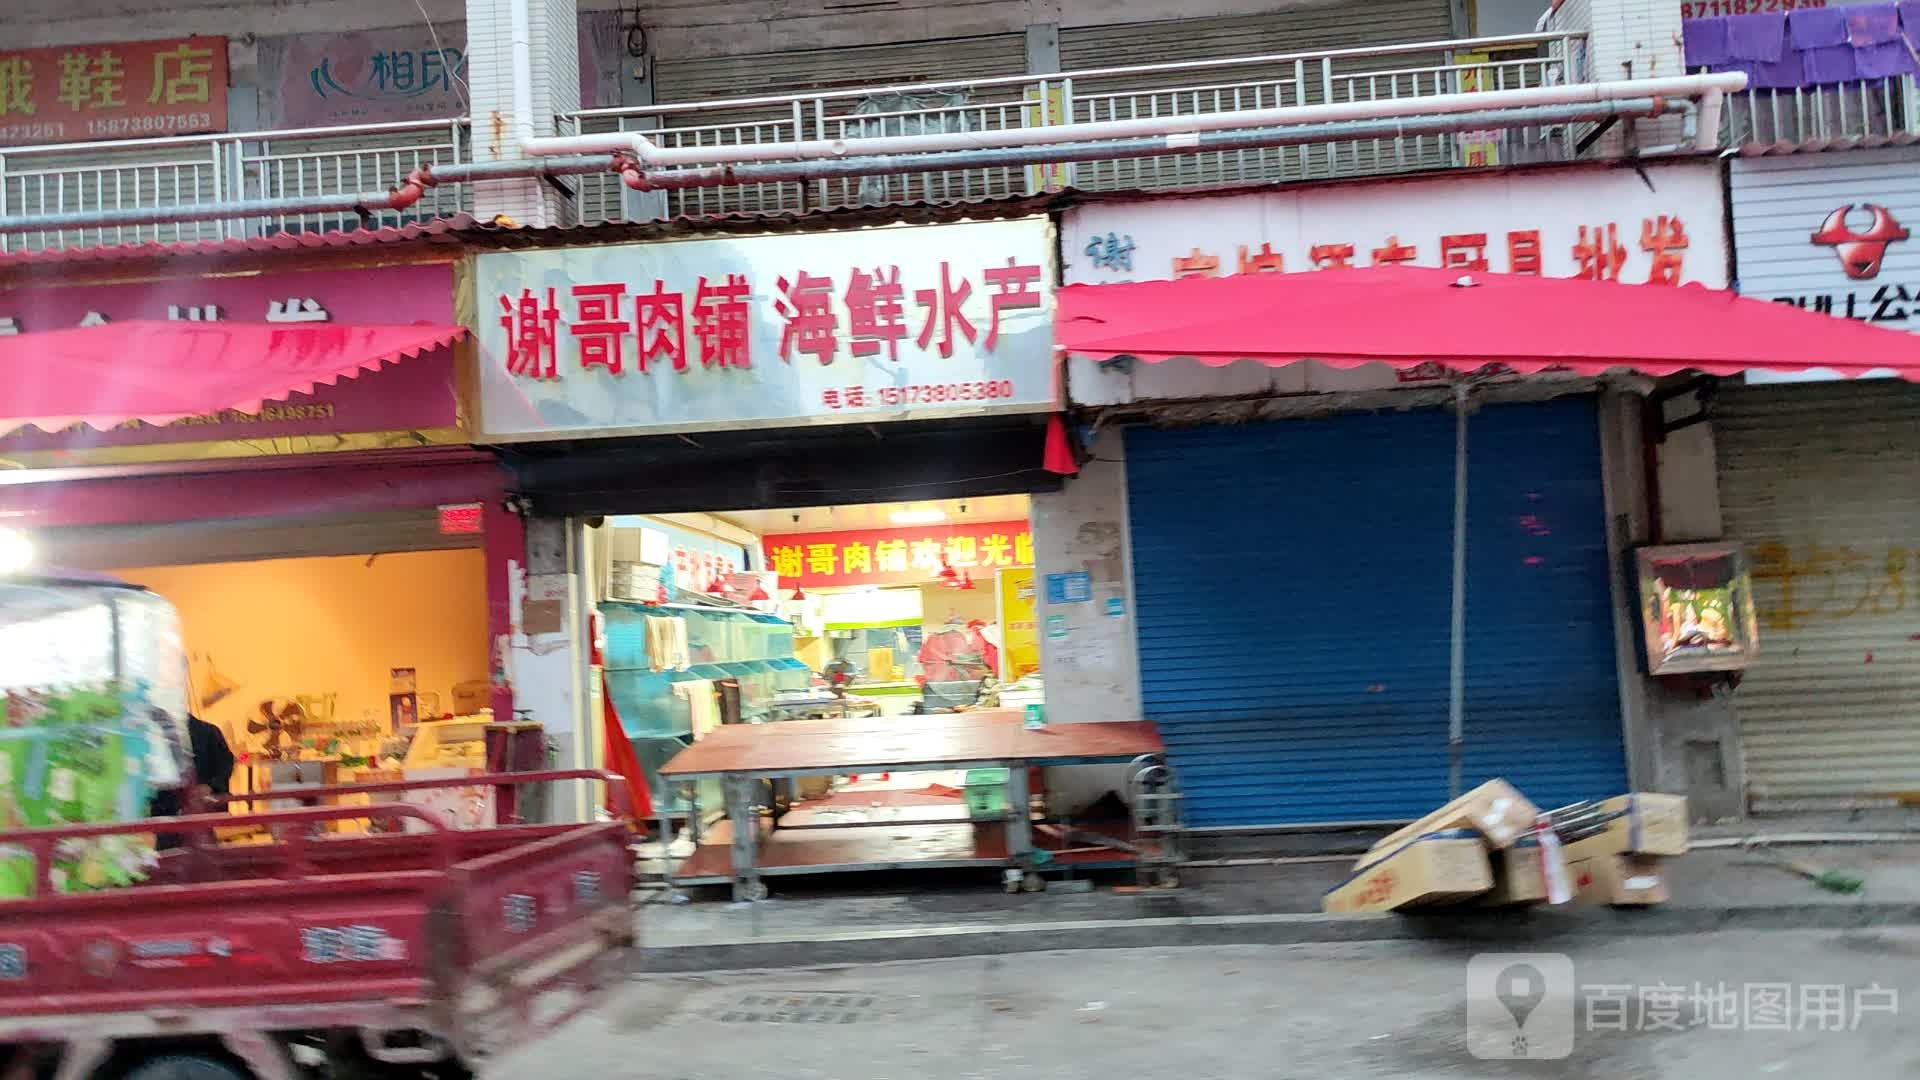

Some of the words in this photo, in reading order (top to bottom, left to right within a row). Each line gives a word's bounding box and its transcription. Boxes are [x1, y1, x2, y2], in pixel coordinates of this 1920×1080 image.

[499, 273, 753, 380] 谢哥肉铺
[773, 256, 1043, 366] 海鲜水产
[1870, 284, 1920, 322] 公
[878, 379, 1014, 405] 15173805380
